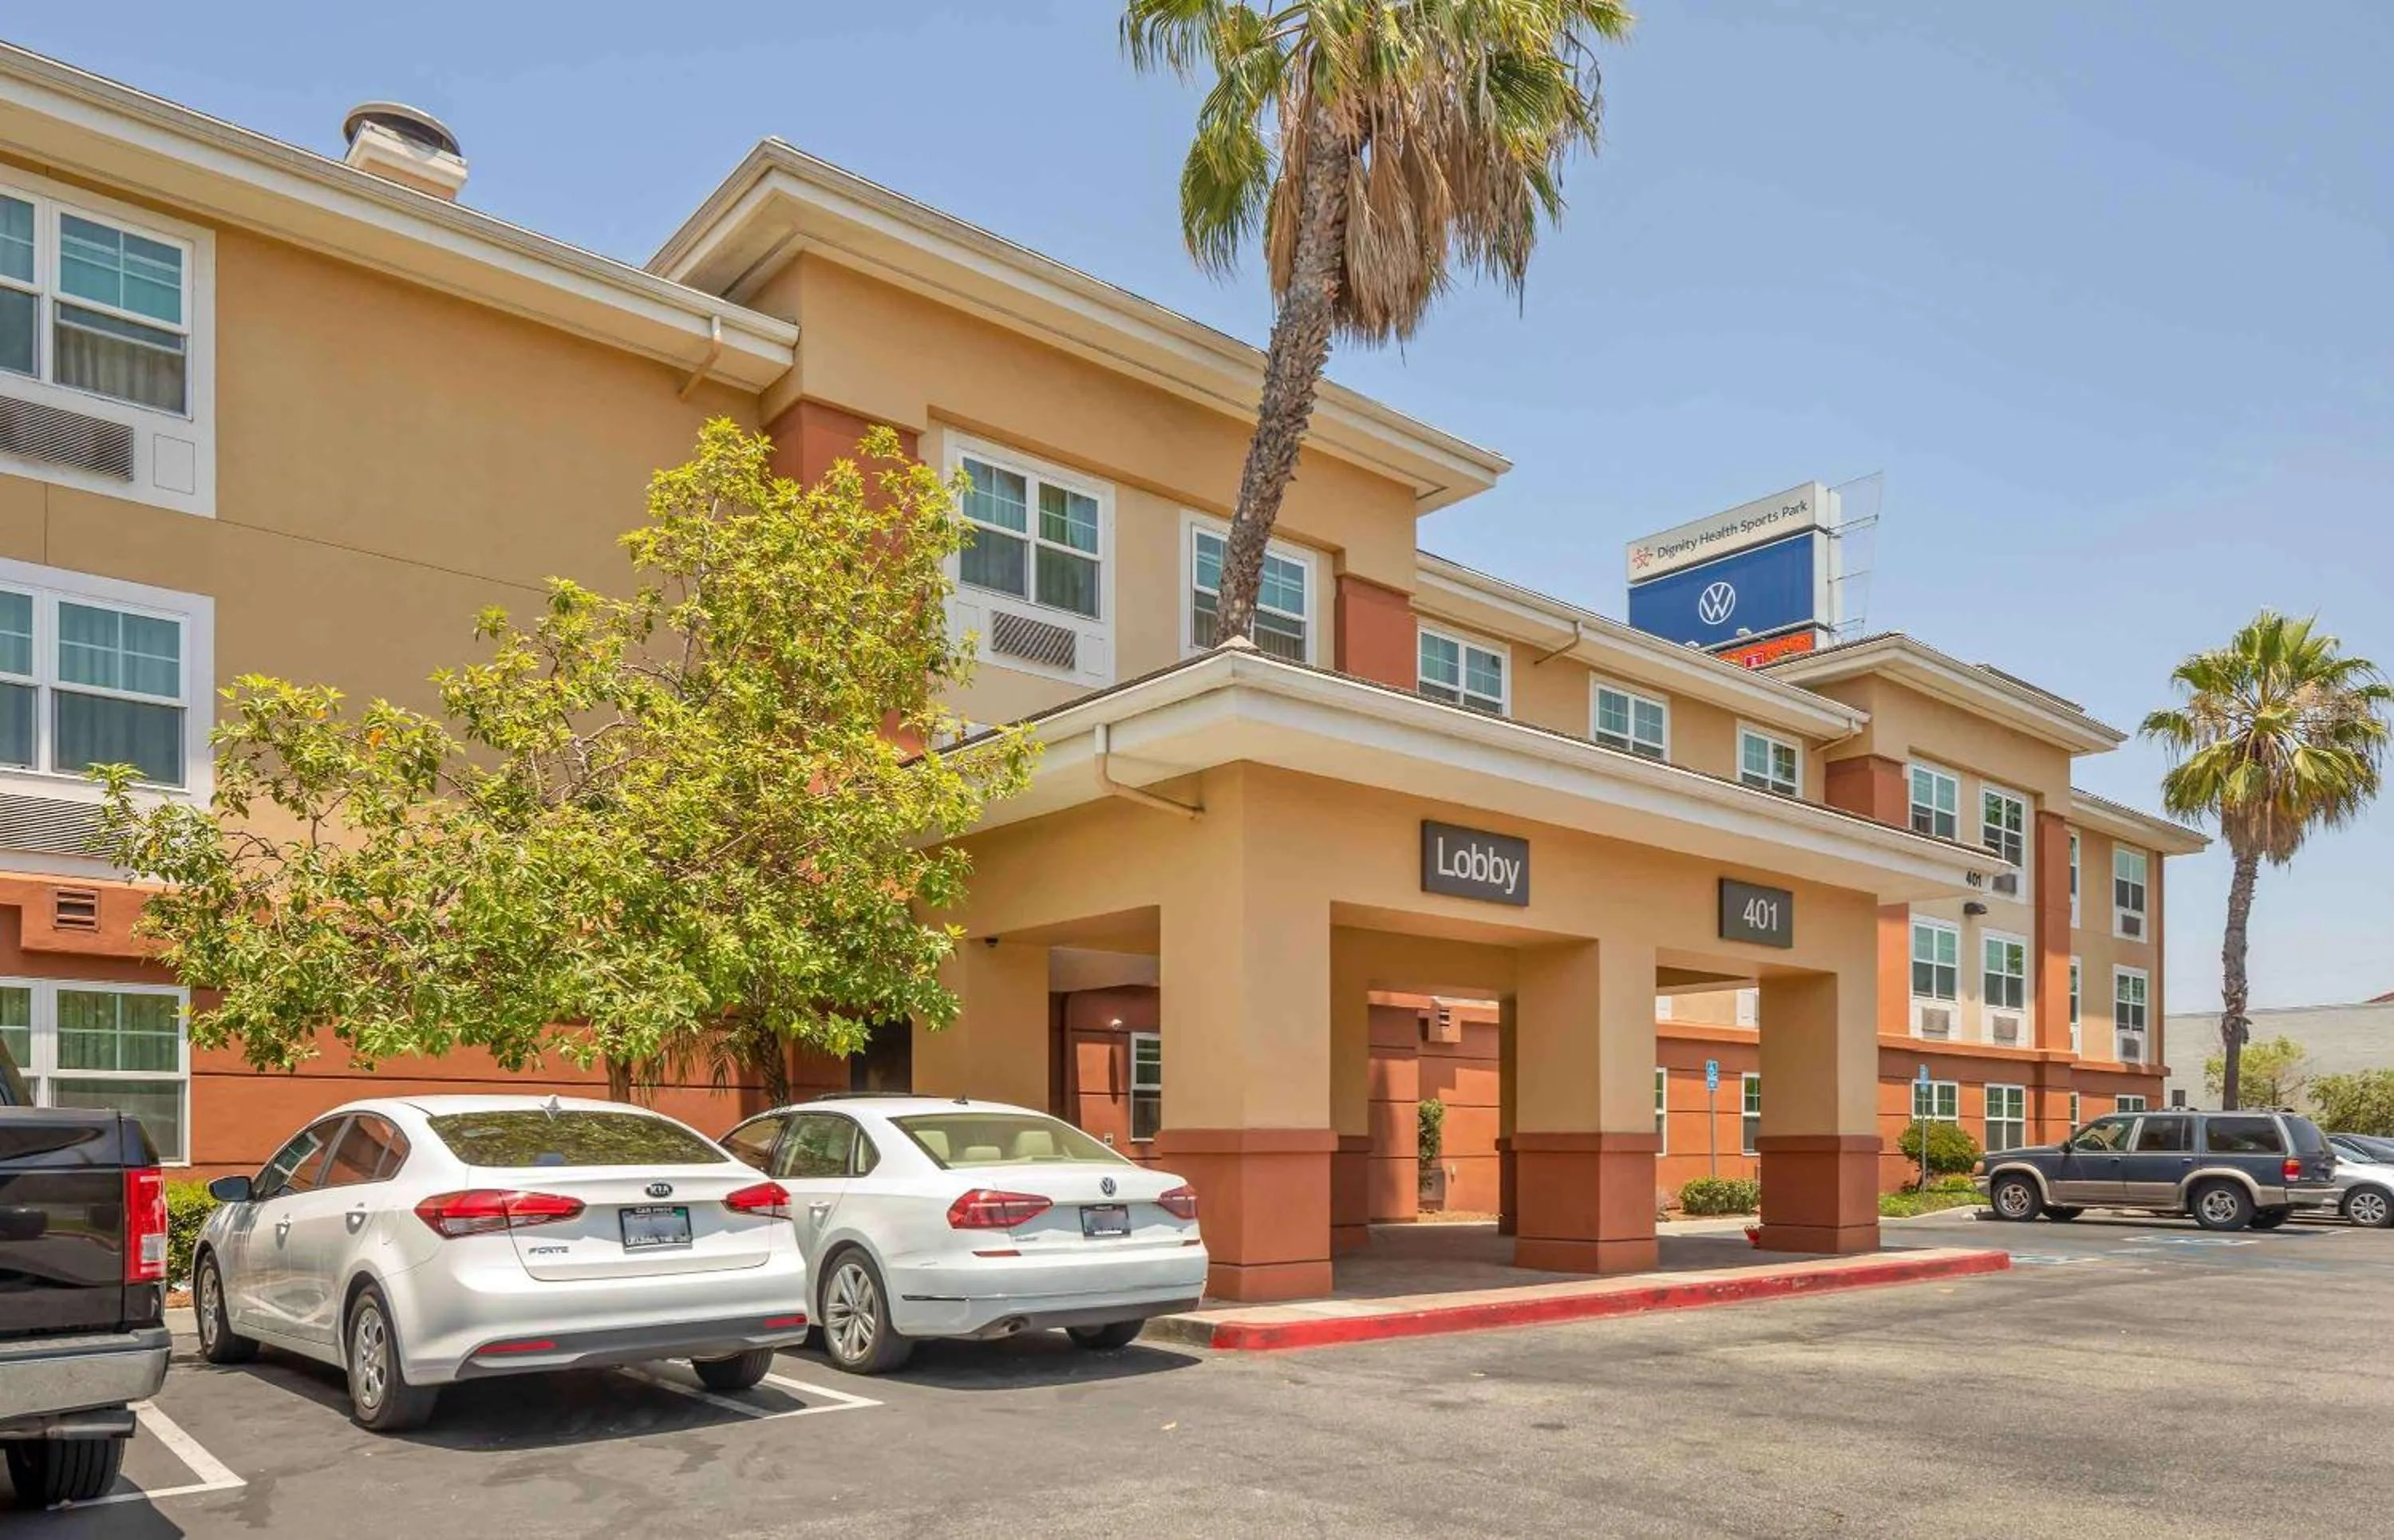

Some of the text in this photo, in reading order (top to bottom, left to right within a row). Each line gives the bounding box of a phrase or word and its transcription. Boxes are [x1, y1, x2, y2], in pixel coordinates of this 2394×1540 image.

[1657, 500, 1807, 559] Dignity Health Sports Park
[1438, 836, 1520, 894] Lobby
[1965, 871, 1982, 887] 401
[1742, 898, 1778, 932] 401
[527, 1246, 569, 1255] FORTE
